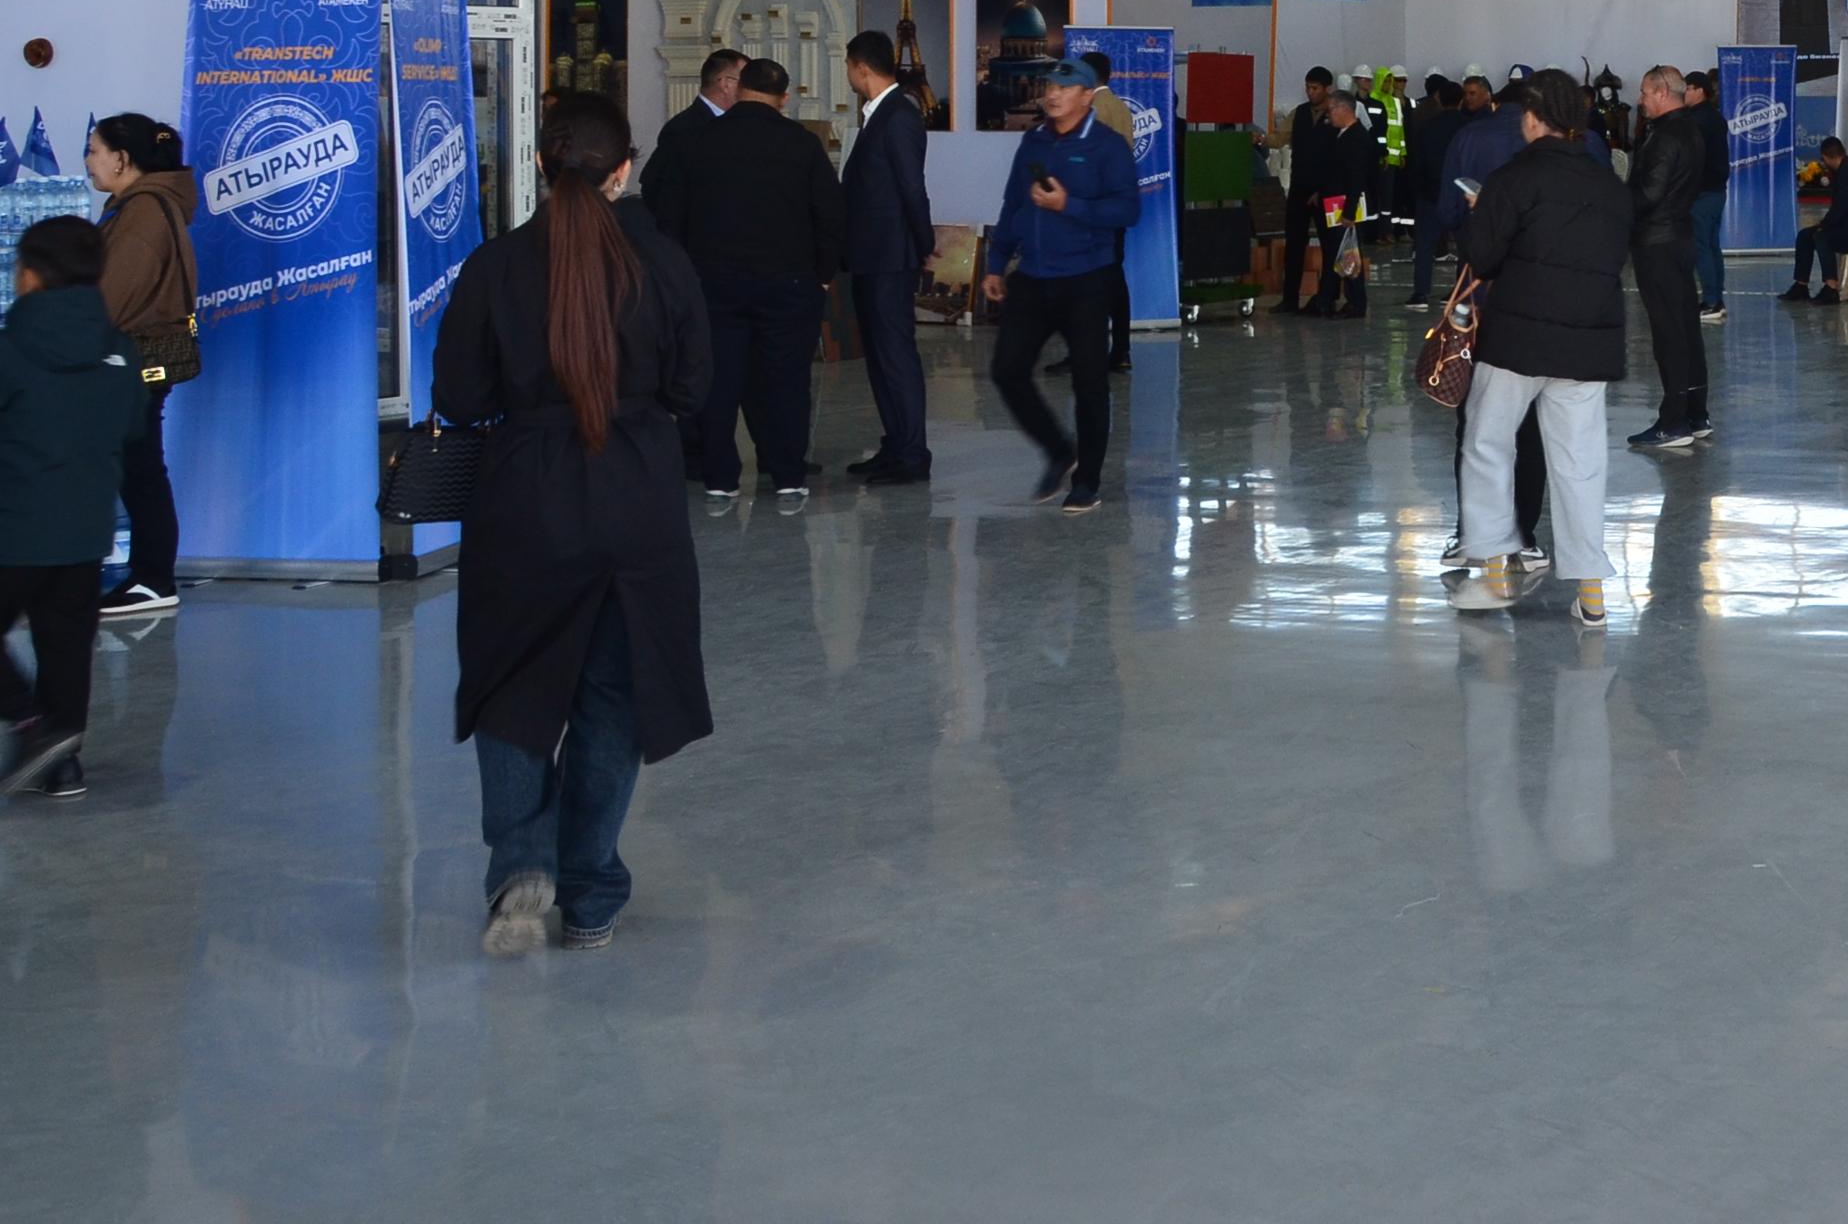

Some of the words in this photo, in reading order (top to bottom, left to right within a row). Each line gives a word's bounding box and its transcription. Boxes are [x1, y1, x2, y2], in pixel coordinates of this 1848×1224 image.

[233, 46, 335, 61] «TRANSTECH
[195, 70, 327, 85] INTERNATIONAL»
[331, 68, 374, 84] ЖШС
[1732, 107, 1785, 131] АТЫРАУДА
[216, 133, 349, 201] АТЫРАУДА
[411, 140, 465, 204] АТЫРАУДА
[1138, 170, 1171, 187] салған
[249, 180, 331, 231] ЖАСАЛҒАН
[196, 276, 273, 310] тырауда
[277, 250, 373, 288] Жасалған
[409, 281, 446, 315] тырауда
